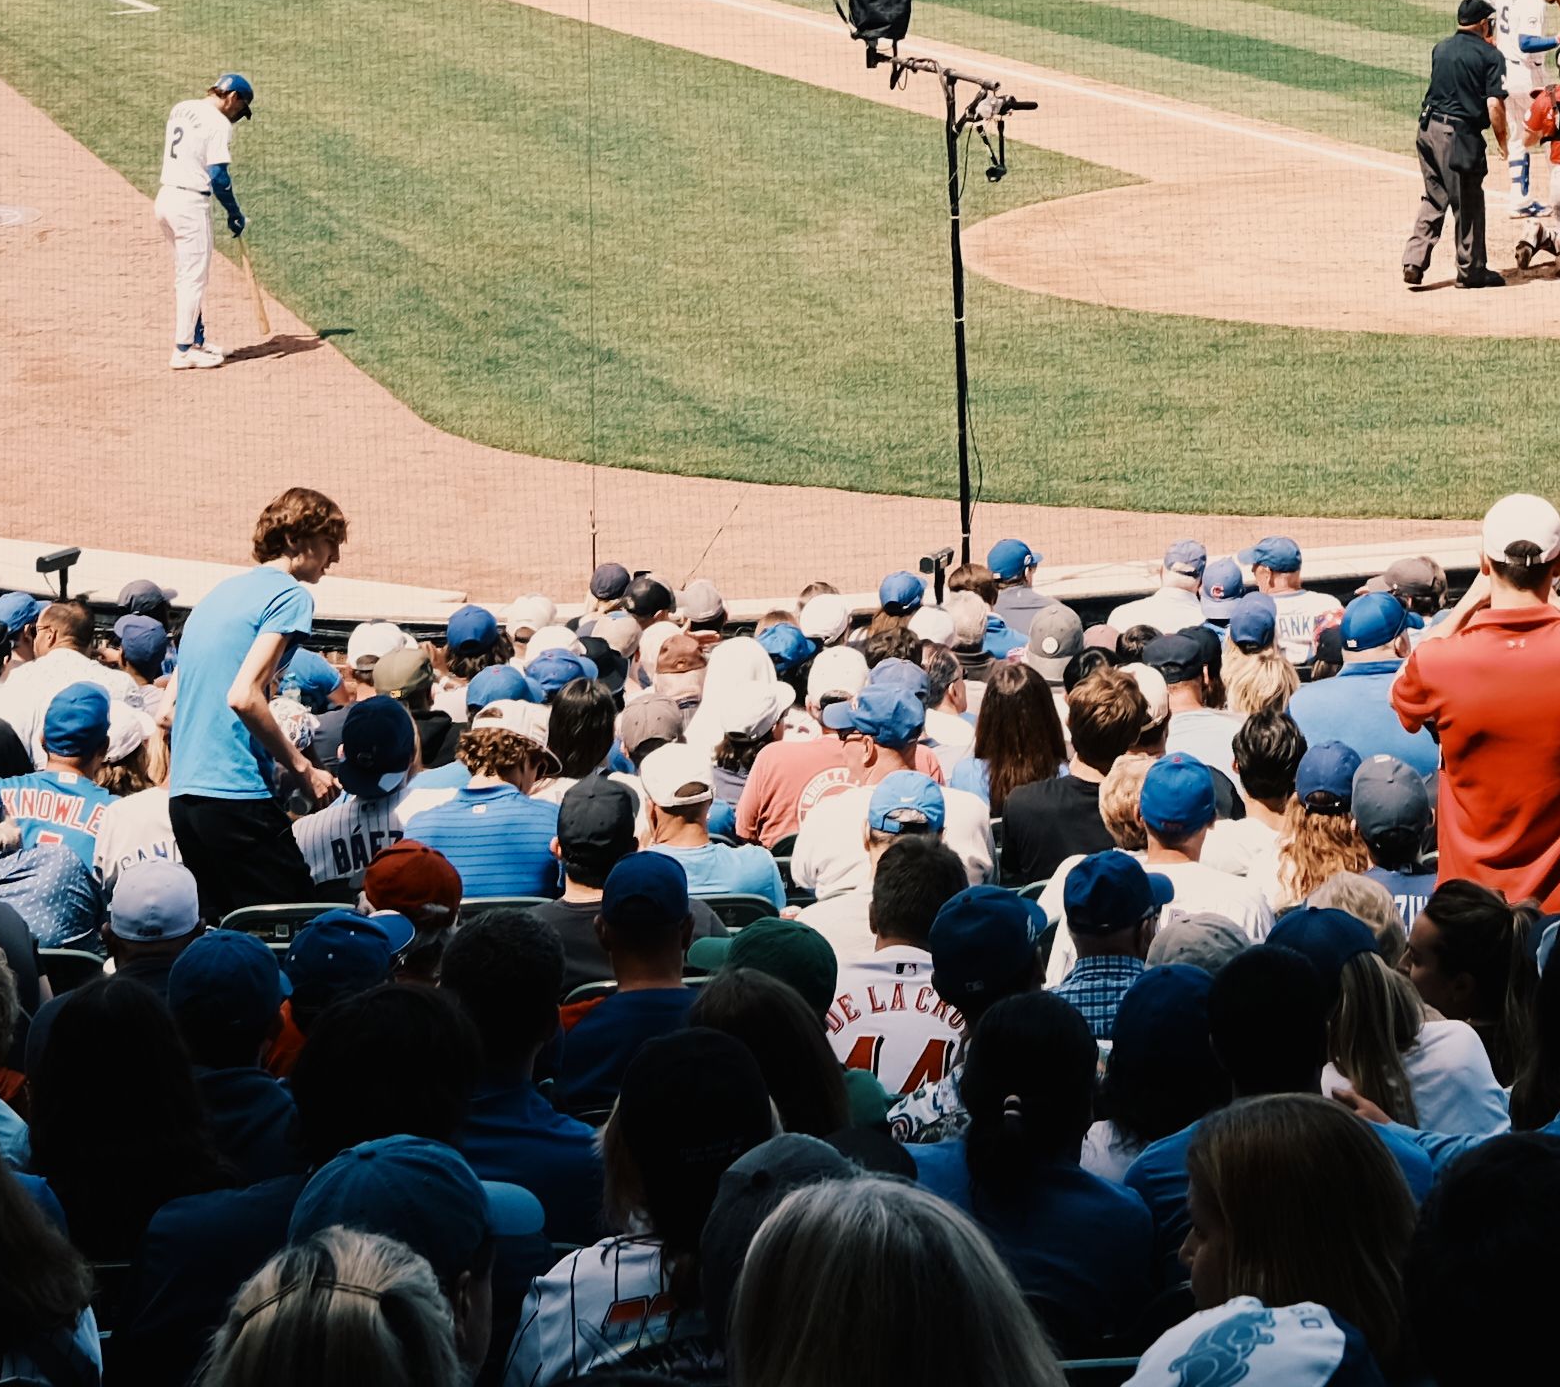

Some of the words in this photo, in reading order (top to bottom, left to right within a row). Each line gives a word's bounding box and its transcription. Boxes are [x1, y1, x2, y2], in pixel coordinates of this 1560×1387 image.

[170, 127, 184, 159] 2
[1, 785, 106, 836] KNOWLE
[868, 982, 908, 1013] LA
